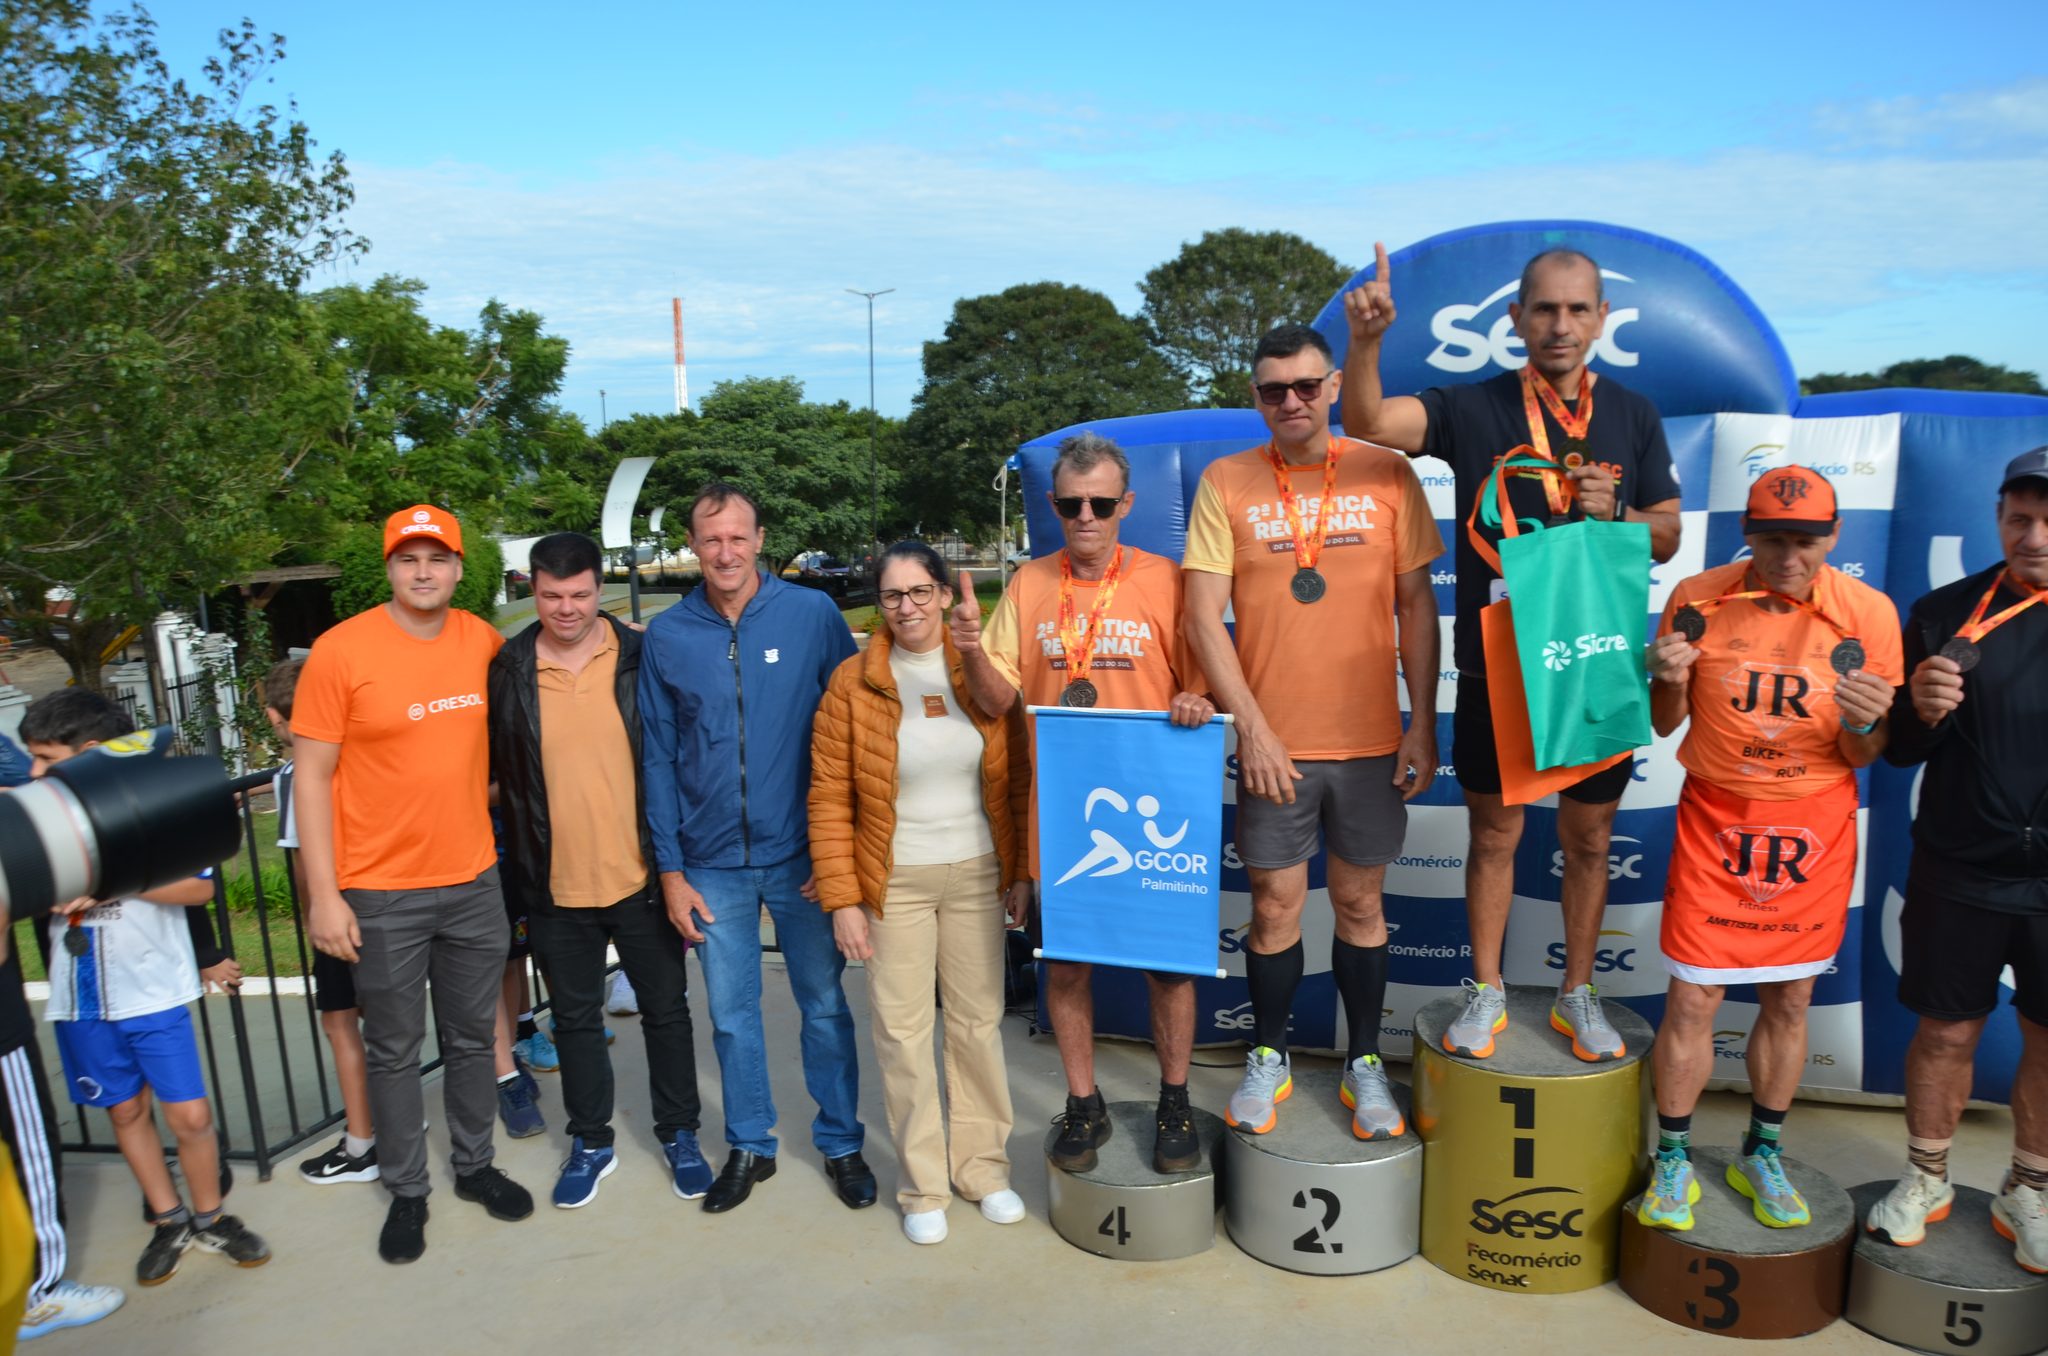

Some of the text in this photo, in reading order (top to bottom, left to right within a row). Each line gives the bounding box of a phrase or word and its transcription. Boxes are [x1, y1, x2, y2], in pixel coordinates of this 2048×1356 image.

[1425, 303, 1640, 374] Sec
[1774, 480, 1809, 500] JR
[401, 524, 444, 535] CRESOL
[1332, 537, 1344, 545] DO
[1345, 536, 1360, 544] SUL
[1575, 633, 1629, 659] Sicre
[428, 693, 484, 714] CRESOL
[1731, 669, 1813, 719] JR
[1776, 766, 1807, 778] RUN
[1134, 850, 1208, 875] GCOR
[1393, 855, 1463, 869] comércio
[1550, 849, 1643, 880] Ssc
[1722, 831, 1809, 885] JR
[1141, 877, 1209, 895] Palmitinho
[1738, 899, 1778, 912] Fitness
[1705, 915, 1759, 931] AMETISTA
[1761, 924, 1778, 932] DO
[1780, 923, 1801, 933] SUL
[1388, 944, 1474, 958] comércio R
[1547, 942, 1636, 973] Ssc
[1813, 1054, 1836, 1066] RS
[1500, 1086, 1535, 1179] 1
[1098, 1206, 1131, 1246] 4
[1292, 1188, 1343, 1254] 2
[1469, 1198, 1584, 1240] Sesc
[1466, 1241, 1582, 1269] Fecomércio
[1467, 1264, 1528, 1288] Senac
[1685, 1257, 1740, 1330] 3
[1944, 1300, 1984, 1348] 5
